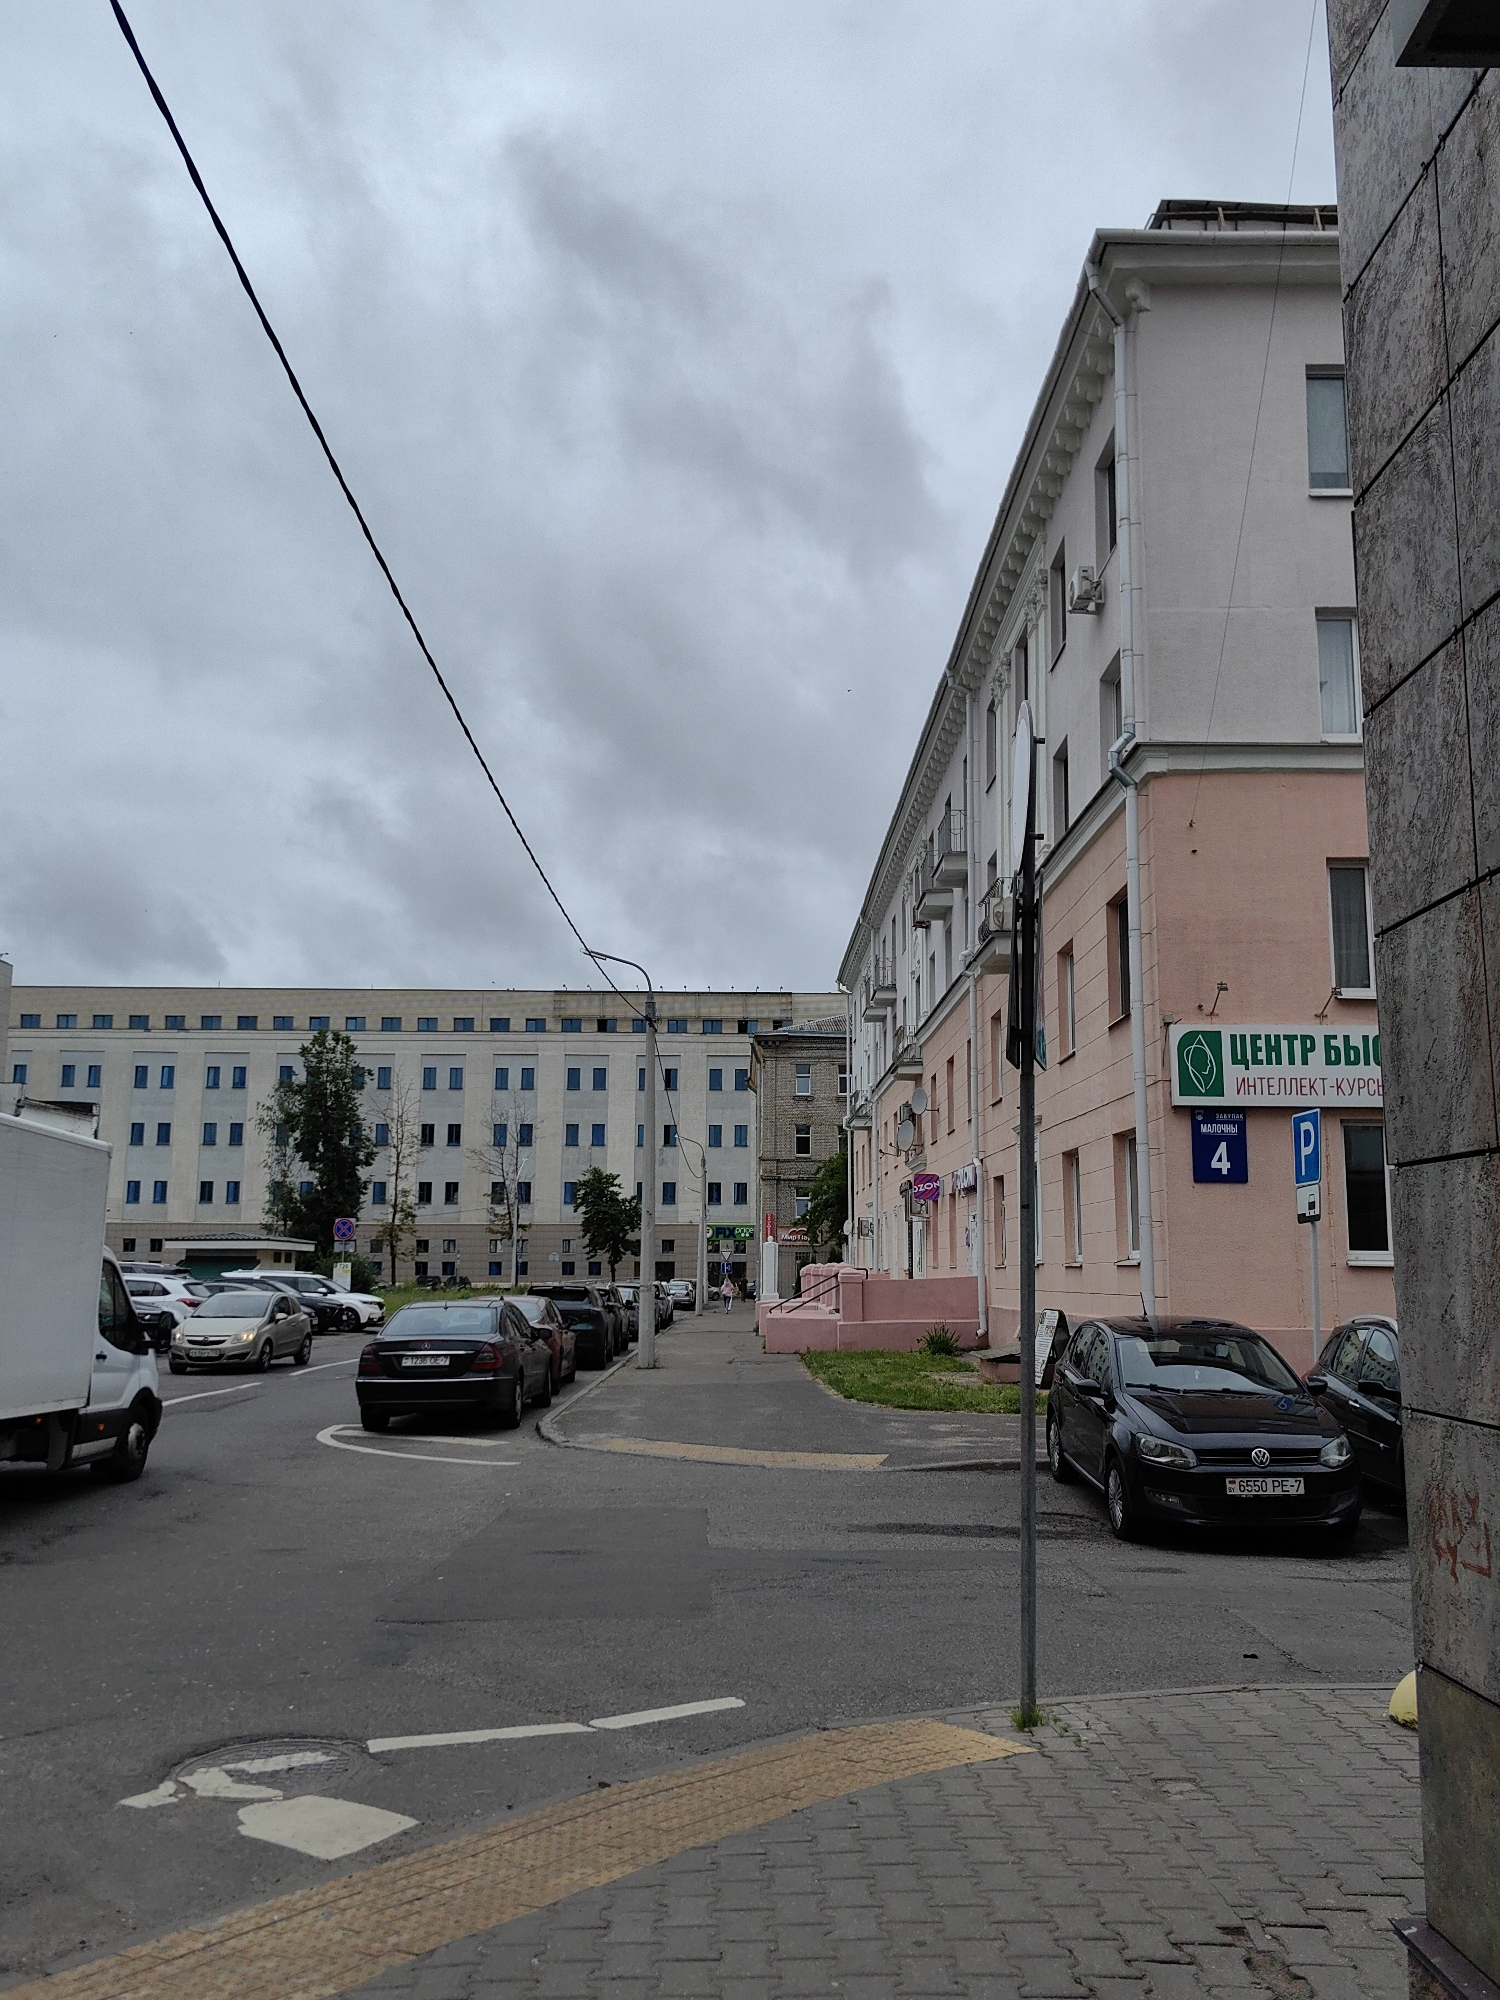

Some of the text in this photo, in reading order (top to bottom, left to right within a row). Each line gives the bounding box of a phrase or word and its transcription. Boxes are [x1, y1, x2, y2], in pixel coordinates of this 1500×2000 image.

[1230, 1034, 1316, 1070] ЦЕНТР
[1201, 1123, 1238, 1133] МАЛОЧНЫ
[1300, 1121, 1315, 1176] P
[1211, 1142, 1230, 1174] 4
[913, 1181, 940, 1192] OZON
[715, 1227, 736, 1238] FIX
[1238, 1480, 1268, 1493] 6550
[1272, 1480, 1302, 1493] PE-7
